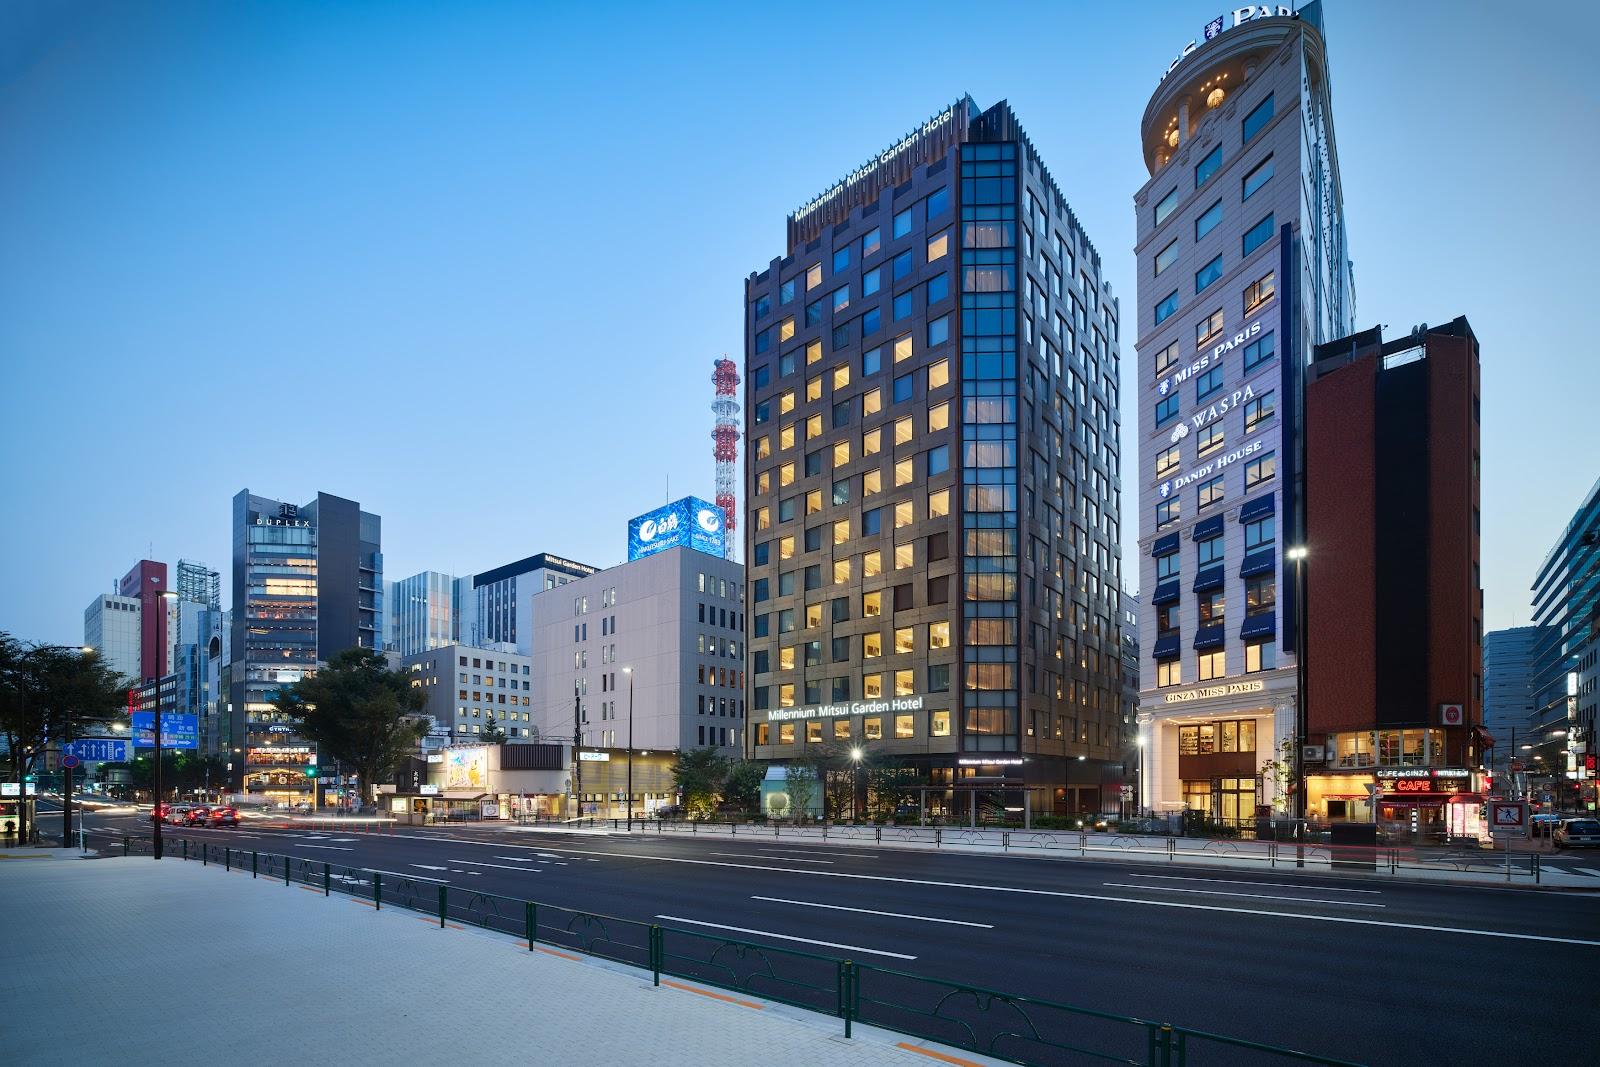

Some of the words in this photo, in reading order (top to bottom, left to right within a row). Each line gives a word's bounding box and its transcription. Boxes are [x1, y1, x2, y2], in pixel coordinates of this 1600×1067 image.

[794, 184, 844, 222] Millennium
[846, 158, 878, 187] Mitsui
[880, 132, 919, 163] Garden
[922, 106, 953, 136] Hotel
[1174, 356, 1209, 385] MISS
[1213, 322, 1262, 360] PARIS
[1192, 385, 1255, 428] WASPA
[1175, 464, 1213, 489] DANDY
[1217, 440, 1262, 469] HOUSE
[256, 519, 310, 527] DUPLEX
[545, 555, 562, 564] Mitsui
[562, 560, 580, 570] Garden
[581, 565, 595, 574] Hotel
[1165, 691, 1195, 702] GINZA
[1199, 687, 1224, 698] MISS
[1227, 681, 1262, 693] PARIS
[768, 707, 815, 721] Millennium
[818, 704, 849, 717] Mitsui
[851, 701, 889, 714] Garden
[892, 697, 923, 711] Hotel
[1397, 780, 1431, 791] CAFE
